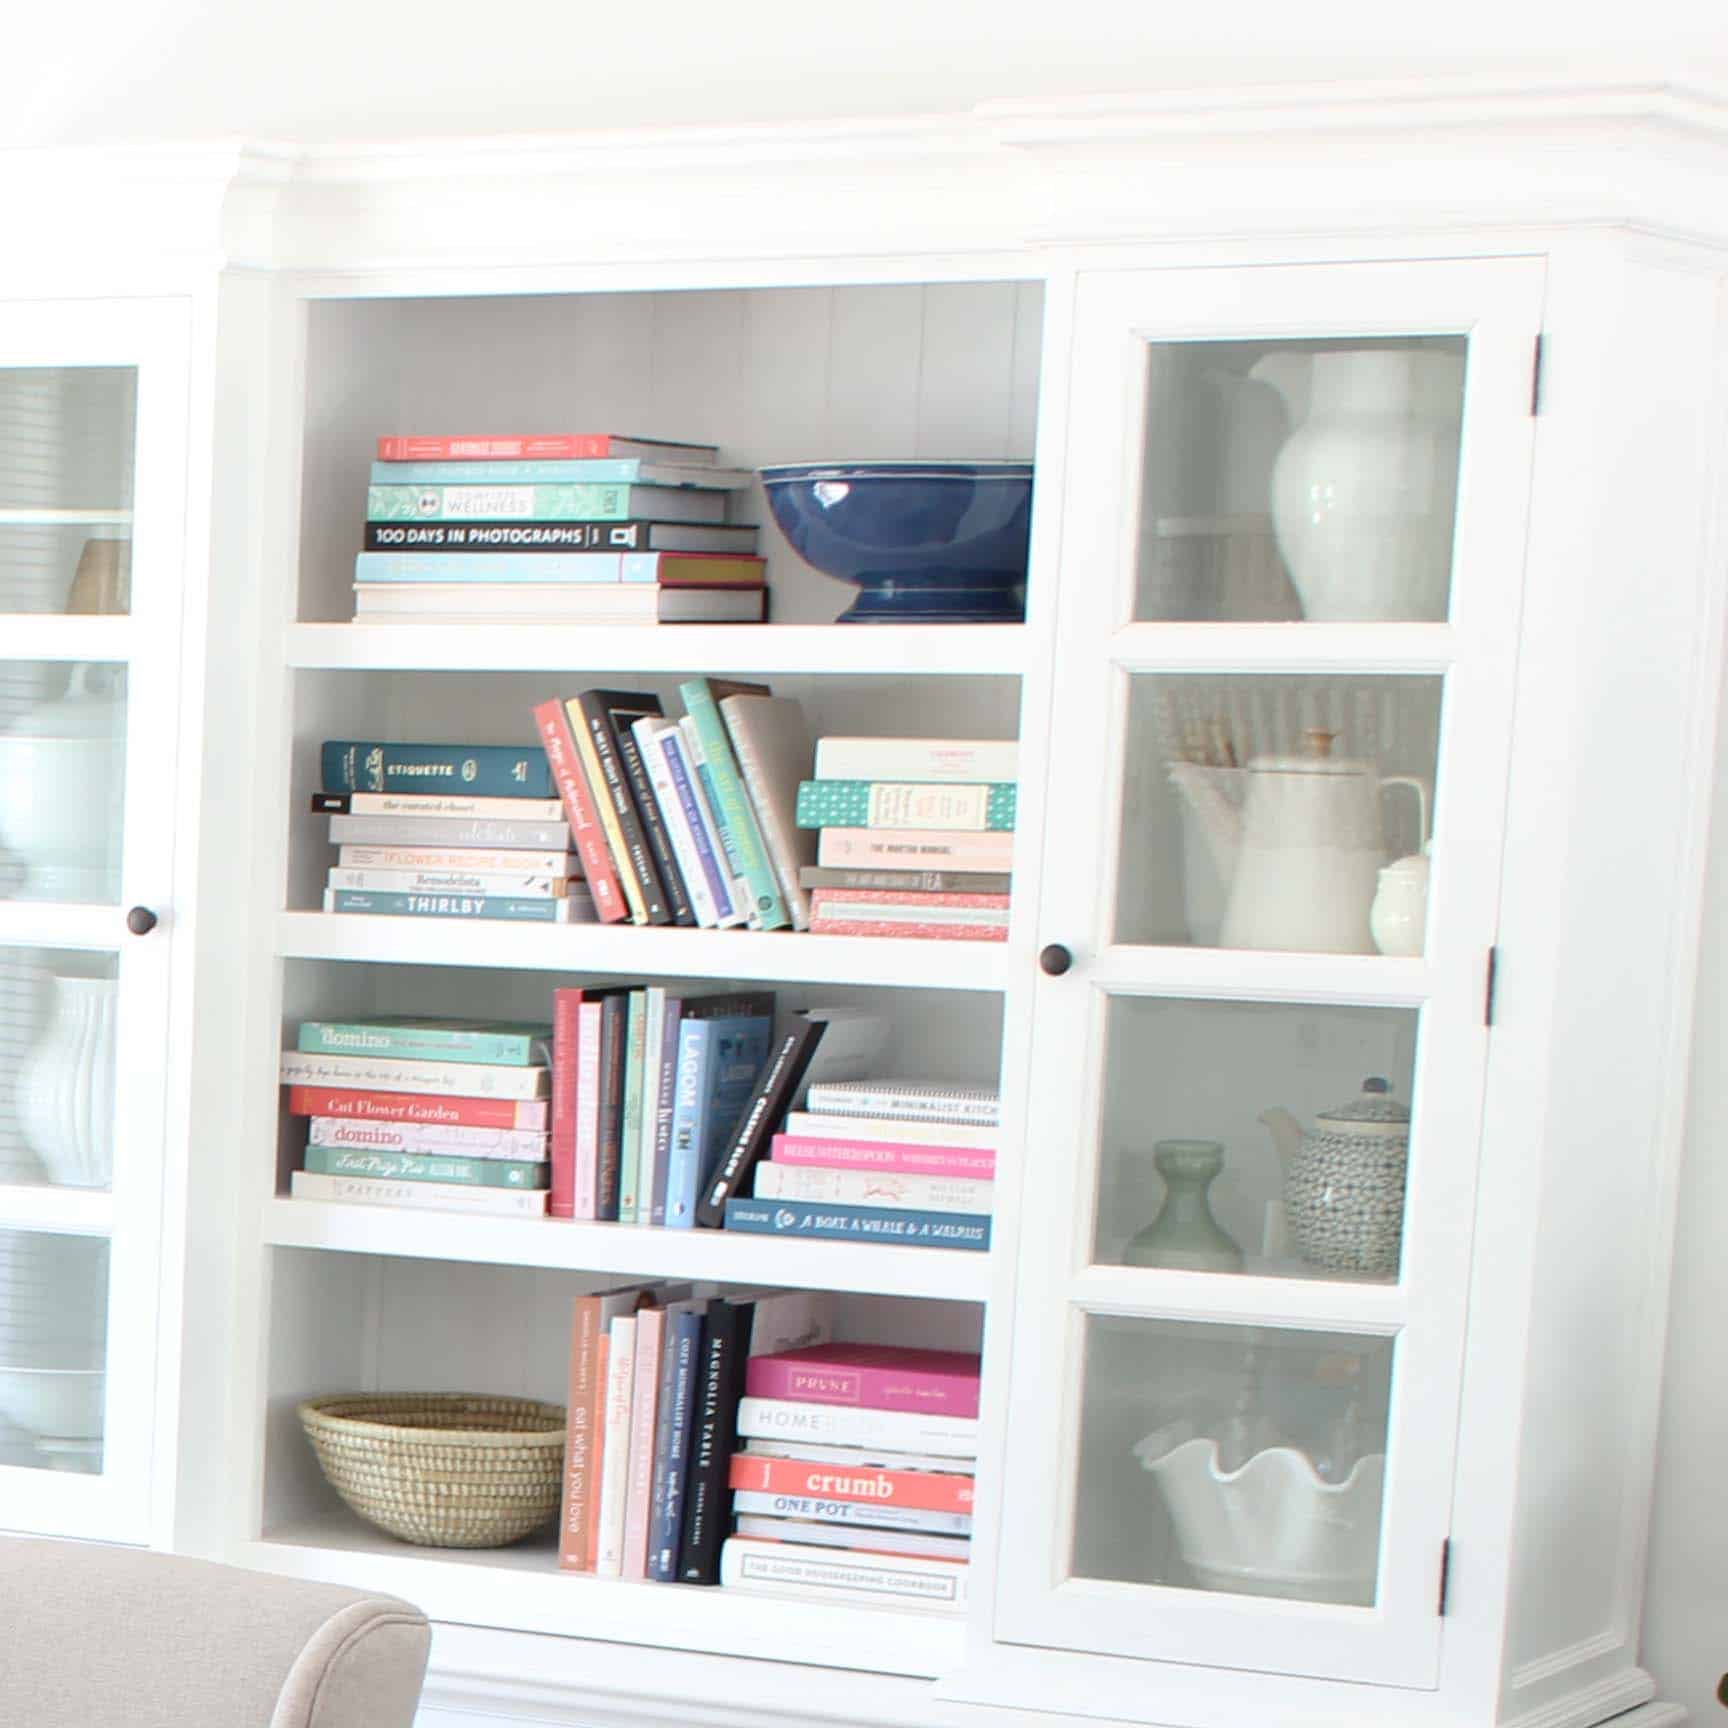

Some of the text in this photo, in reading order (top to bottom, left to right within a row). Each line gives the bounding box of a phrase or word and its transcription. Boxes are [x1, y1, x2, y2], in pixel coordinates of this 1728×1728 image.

[447, 499, 526, 513] WELLNESS
[376, 527, 582, 544] 100 DAYS IN PHOTOGRAPHS
[387, 764, 454, 777] ETIQUETTE
[408, 896, 486, 914] THIRLBY
[321, 1027, 391, 1049] domino
[679, 1034, 701, 1107] LAGOM
[328, 1099, 461, 1122] Cut Flower Garden
[335, 1127, 404, 1145] domino
[724, 1097, 767, 1177] CHASING SLOW
[699, 1338, 723, 1468] MAGNOLIA TABLE
[758, 1409, 821, 1429] HOME
[574, 1435, 587, 1469] what
[569, 1471, 584, 1504] you
[806, 1472, 894, 1499] crumb
[774, 1497, 811, 1513] ONE
[815, 1501, 850, 1517] POT
[567, 1504, 582, 1533] love
